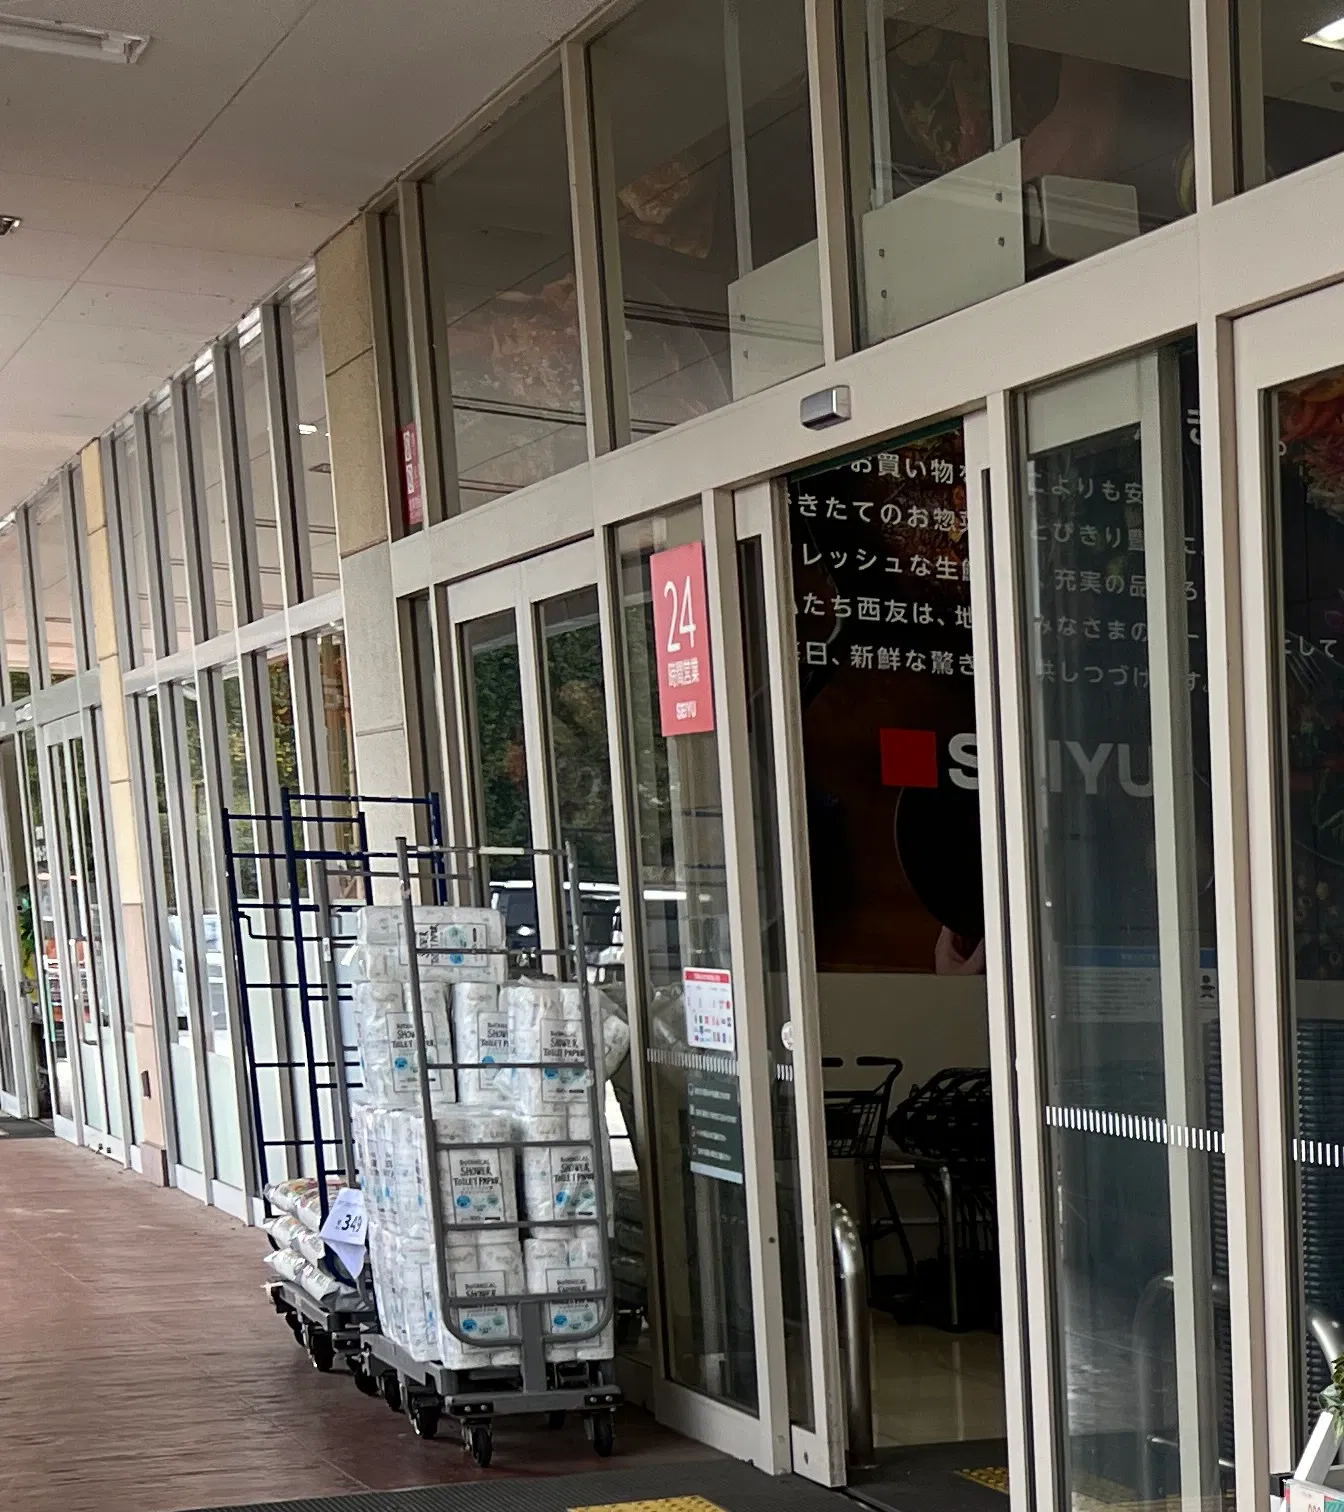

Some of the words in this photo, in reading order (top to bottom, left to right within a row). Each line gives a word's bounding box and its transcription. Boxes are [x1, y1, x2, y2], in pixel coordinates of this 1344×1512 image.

[837, 453, 967, 484] お買い物
[787, 494, 968, 533] きたてのお惣
[790, 544, 970, 583] レッシュな生
[664, 576, 697, 653] 24
[794, 592, 973, 629] たち西友は、地
[796, 641, 975, 677] 日、新鮮な驚き
